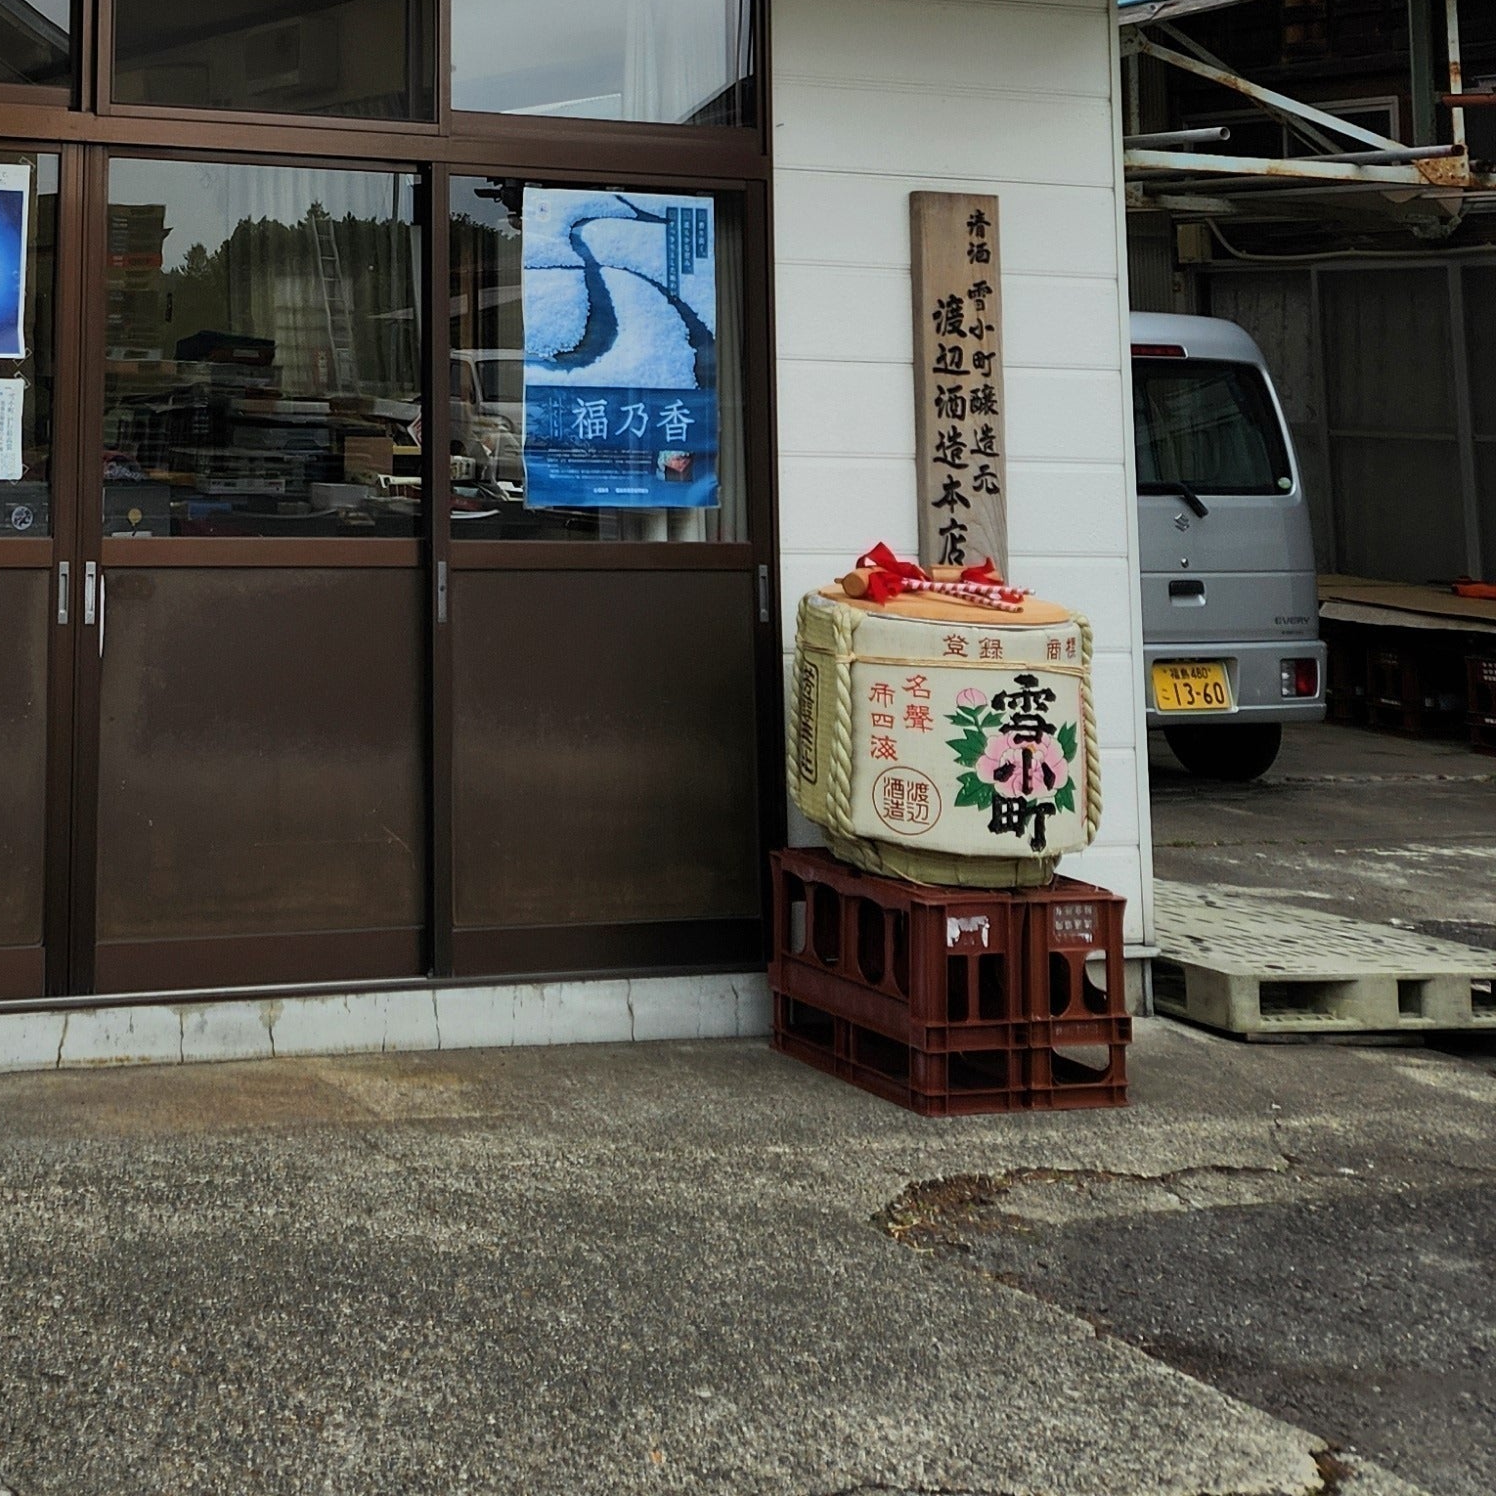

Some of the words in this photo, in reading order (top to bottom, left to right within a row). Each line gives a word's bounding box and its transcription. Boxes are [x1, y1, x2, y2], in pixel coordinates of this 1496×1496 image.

[967, 209, 992, 265] 清酒
[570, 397, 695, 443] 福乃香
[932, 294, 971, 567] 渡辺酒造本店
[943, 634, 1003, 660] 登録
[1174, 682, 1225, 706] 13-60
[988, 674, 1056, 852] 雪小町
